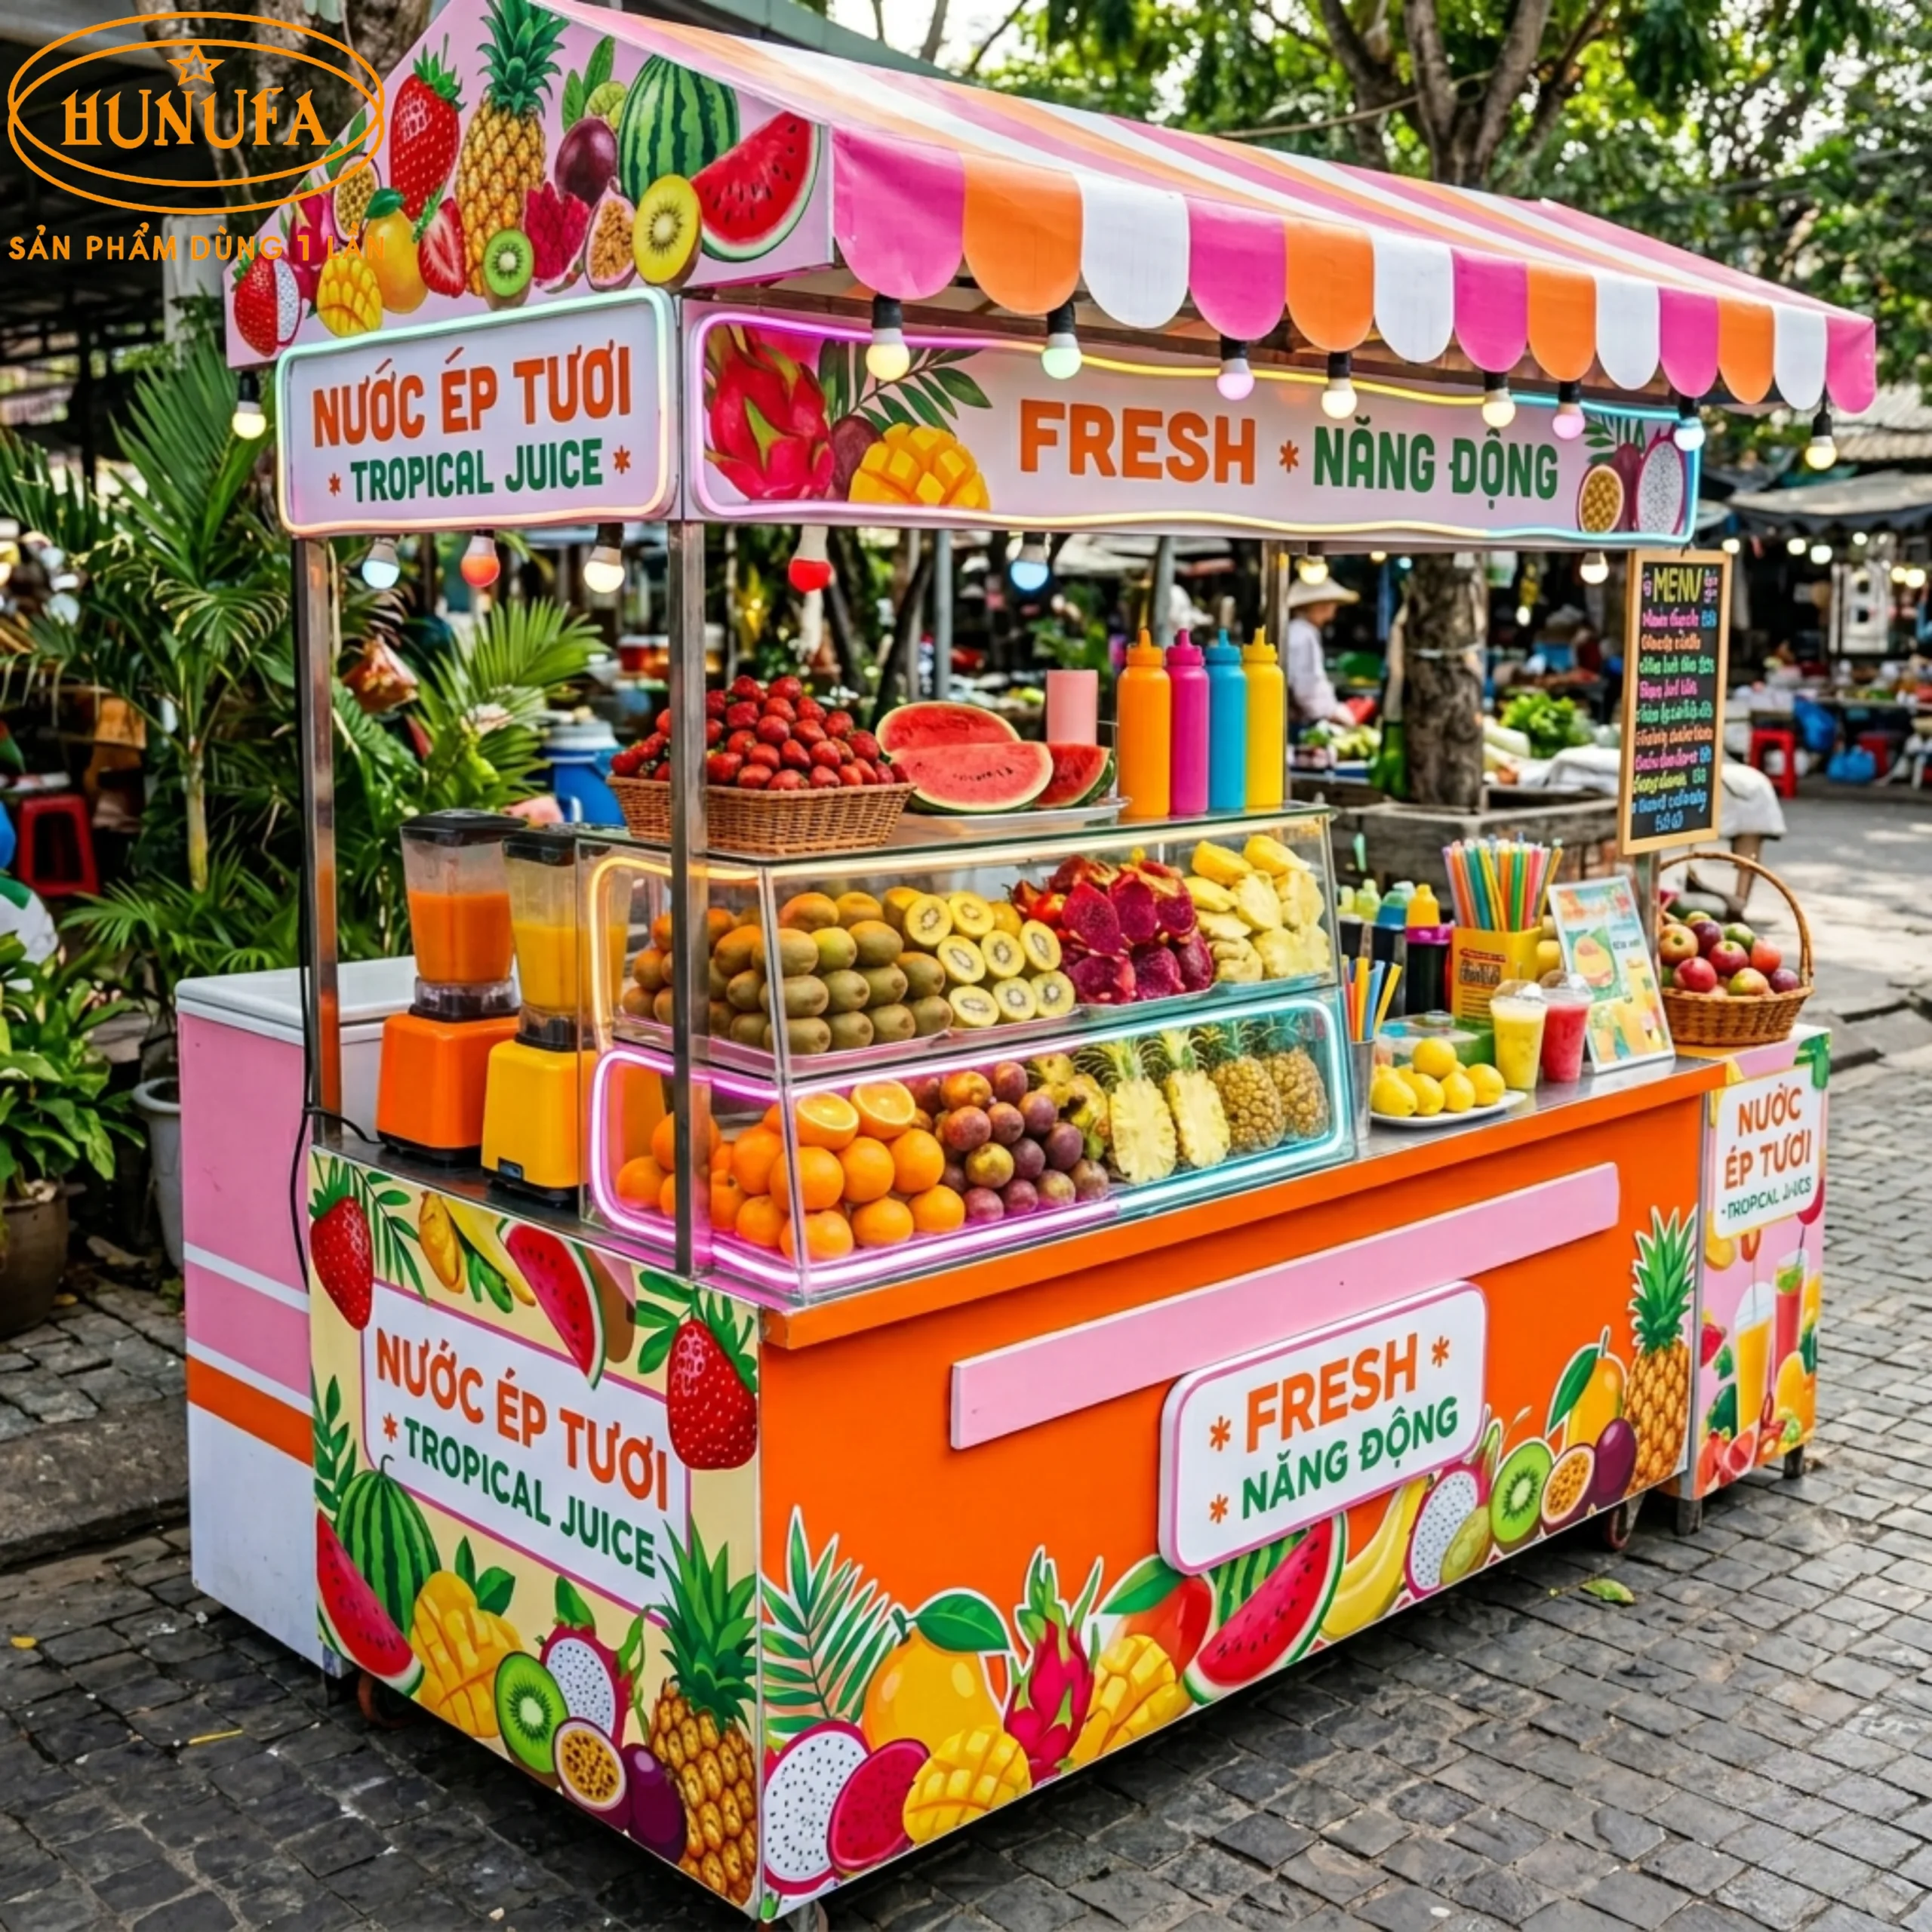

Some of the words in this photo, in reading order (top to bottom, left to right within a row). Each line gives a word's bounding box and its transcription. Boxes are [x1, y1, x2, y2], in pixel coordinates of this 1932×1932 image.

[312, 358, 425, 448] NƯỚC
[441, 346, 497, 434] ÉP
[513, 339, 631, 425] TƯƠI
[350, 450, 494, 503] TROPICAL
[505, 438, 603, 492] JUICE
[1020, 398, 1256, 485] FRESH
[1314, 415, 1435, 493] NĂNG
[1449, 428, 1558, 509] ĐỘNG
[1724, 1145, 1753, 1190] ÉP
[377, 1327, 485, 1423] NƯỚC
[497, 1367, 547, 1448] ÉP
[559, 1407, 667, 1512] TƯƠI
[1246, 1333, 1418, 1454] FRESH
[404, 1417, 551, 1527] TROPICAL
[560, 1496, 656, 1579] JUICE
[1241, 1439, 1349, 1520] NĂNG
[1358, 1396, 1458, 1472] ĐỘNG
